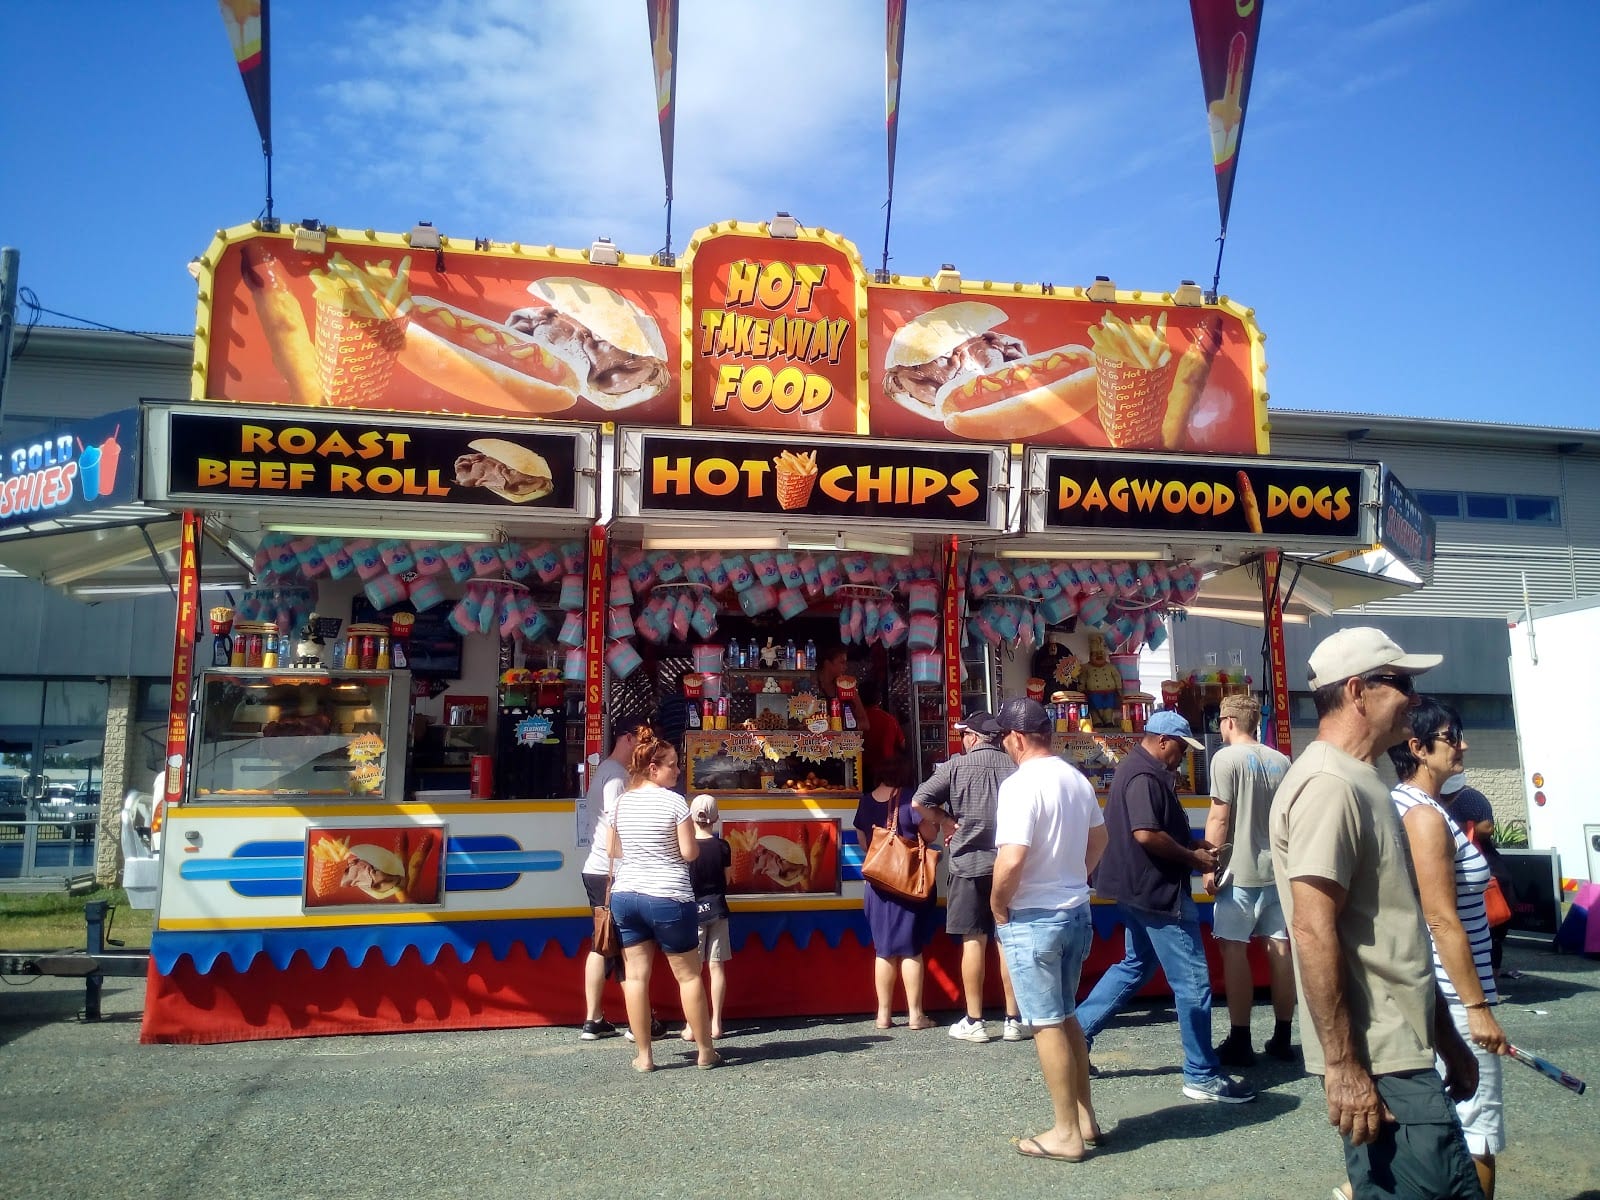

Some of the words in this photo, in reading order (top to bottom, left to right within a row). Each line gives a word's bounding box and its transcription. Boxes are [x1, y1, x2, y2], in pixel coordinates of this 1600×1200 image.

[726, 259, 827, 314] HOT
[331, 320, 345, 331] Go
[350, 320, 374, 330] Hot
[333, 331, 364, 343] Food
[700, 309, 850, 365] TAKEAWAY
[338, 345, 356, 354] Go
[342, 352, 374, 365] Food
[1104, 357, 1123, 369] Food
[335, 368, 345, 376] 2
[350, 365, 367, 373] Go
[1108, 371, 1119, 380] Go
[1123, 368, 1141, 380] Hot
[712, 364, 834, 416] FOOD
[1111, 380, 1135, 391] Food
[1116, 393, 1130, 401] Go
[1120, 398, 1144, 411] Food
[1126, 410, 1140, 419] Go
[241, 424, 412, 461] ROAST
[11, 435, 74, 475] COLD
[197, 457, 317, 490] BEEF
[330, 463, 452, 497] ROLL
[653, 456, 771, 498] HOT
[819, 464, 980, 507] CHIPS
[1058, 475, 1236, 517] DAGWOOD
[1267, 484, 1352, 522] DOGS
[174, 523, 196, 702] WAFFLES
[590, 539, 604, 704] WAFFLES
